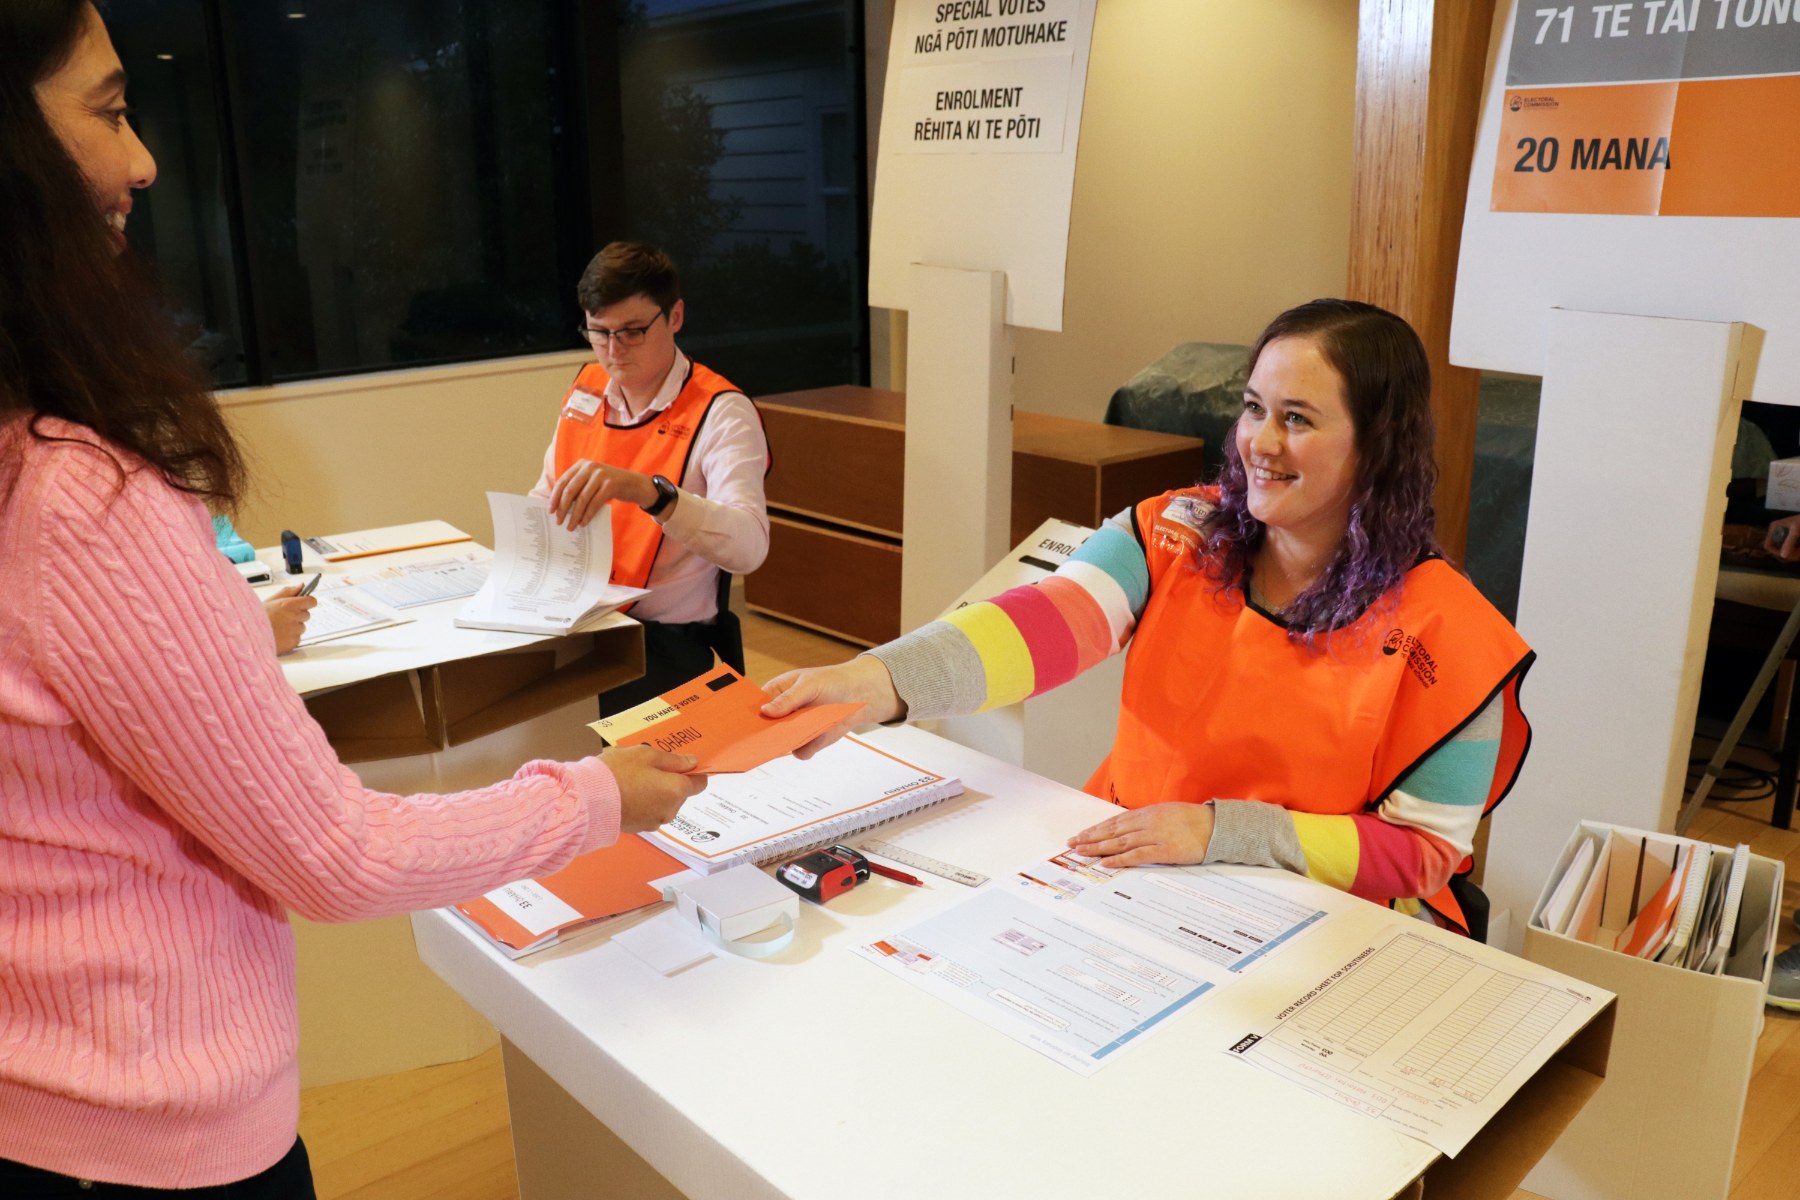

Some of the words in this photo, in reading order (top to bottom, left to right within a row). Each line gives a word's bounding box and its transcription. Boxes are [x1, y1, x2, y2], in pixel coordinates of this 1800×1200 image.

[935, 0, 992, 23] SPECIAL
[998, 0, 1046, 17] VOTES
[1534, 7, 1574, 45] 71
[1591, 3, 1631, 39] TE
[1643, 0, 1700, 35] TAI
[1715, 0, 1800, 29] TON
[914, 28, 942, 54] NGĀ
[946, 25, 978, 51] PŌTI
[981, 20, 1068, 48] MOTUHAKE
[936, 87, 1023, 111] ENROLMENT
[914, 118, 962, 141] RĒHITA
[966, 119, 980, 140] KI
[986, 119, 1003, 139] TE
[1006, 113, 1041, 139] PŌTI
[1514, 137, 1559, 173] 20
[1570, 136, 1671, 171] MANA
[1402, 643, 1438, 685] CISSION
[1405, 635, 1438, 673] ELTORAL
[642, 713, 659, 722] YOU
[658, 706, 676, 717] HAVE
[679, 694, 700, 707] VOTES
[597, 719, 613, 728] 33
[654, 726, 702, 753] ŌHĀRIU
[669, 820, 694, 835] ELECT
[519, 900, 532, 909] 33
[1275, 1004, 1296, 1021] VOTER
[1293, 990, 1318, 1007] RECORD
[1315, 978, 1334, 992] SHEET
[1331, 970, 1344, 982] FOR
[1341, 946, 1376, 973] SCRUTINEERS
[1233, 1038, 1254, 1054] FORM
